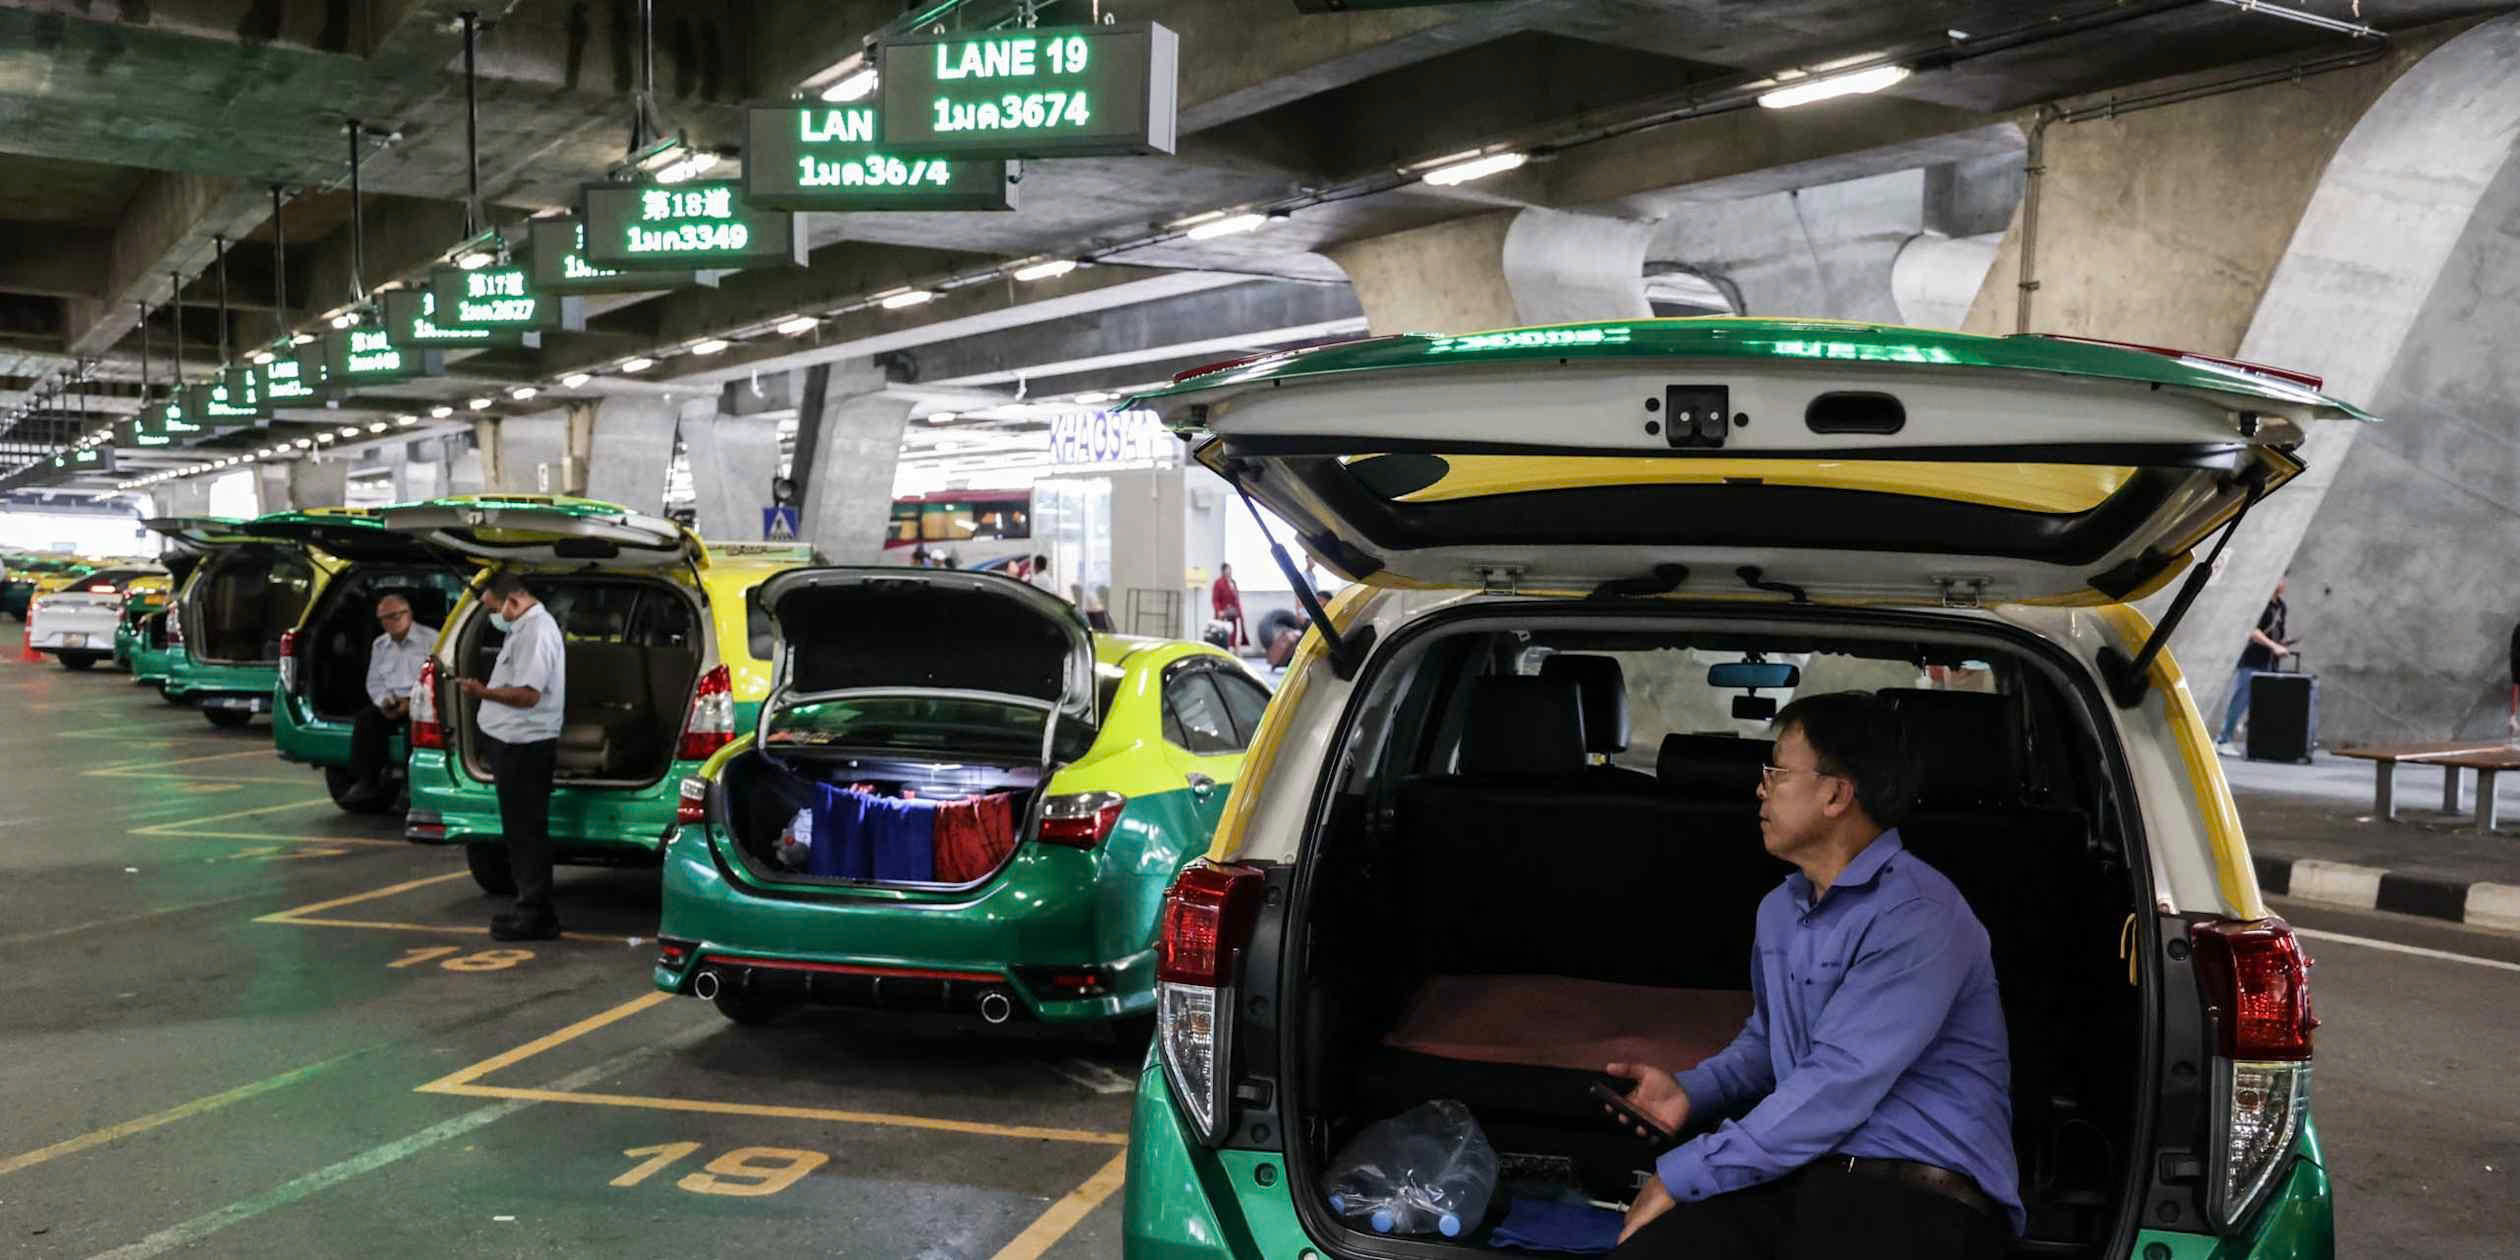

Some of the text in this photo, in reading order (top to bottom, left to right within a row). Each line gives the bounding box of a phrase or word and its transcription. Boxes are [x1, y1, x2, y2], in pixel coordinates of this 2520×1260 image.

[936, 37, 1088, 79] LANE 19
[801, 110, 873, 142] LAN
[386, 946, 536, 971] 18
[608, 1141, 830, 1196] 19
